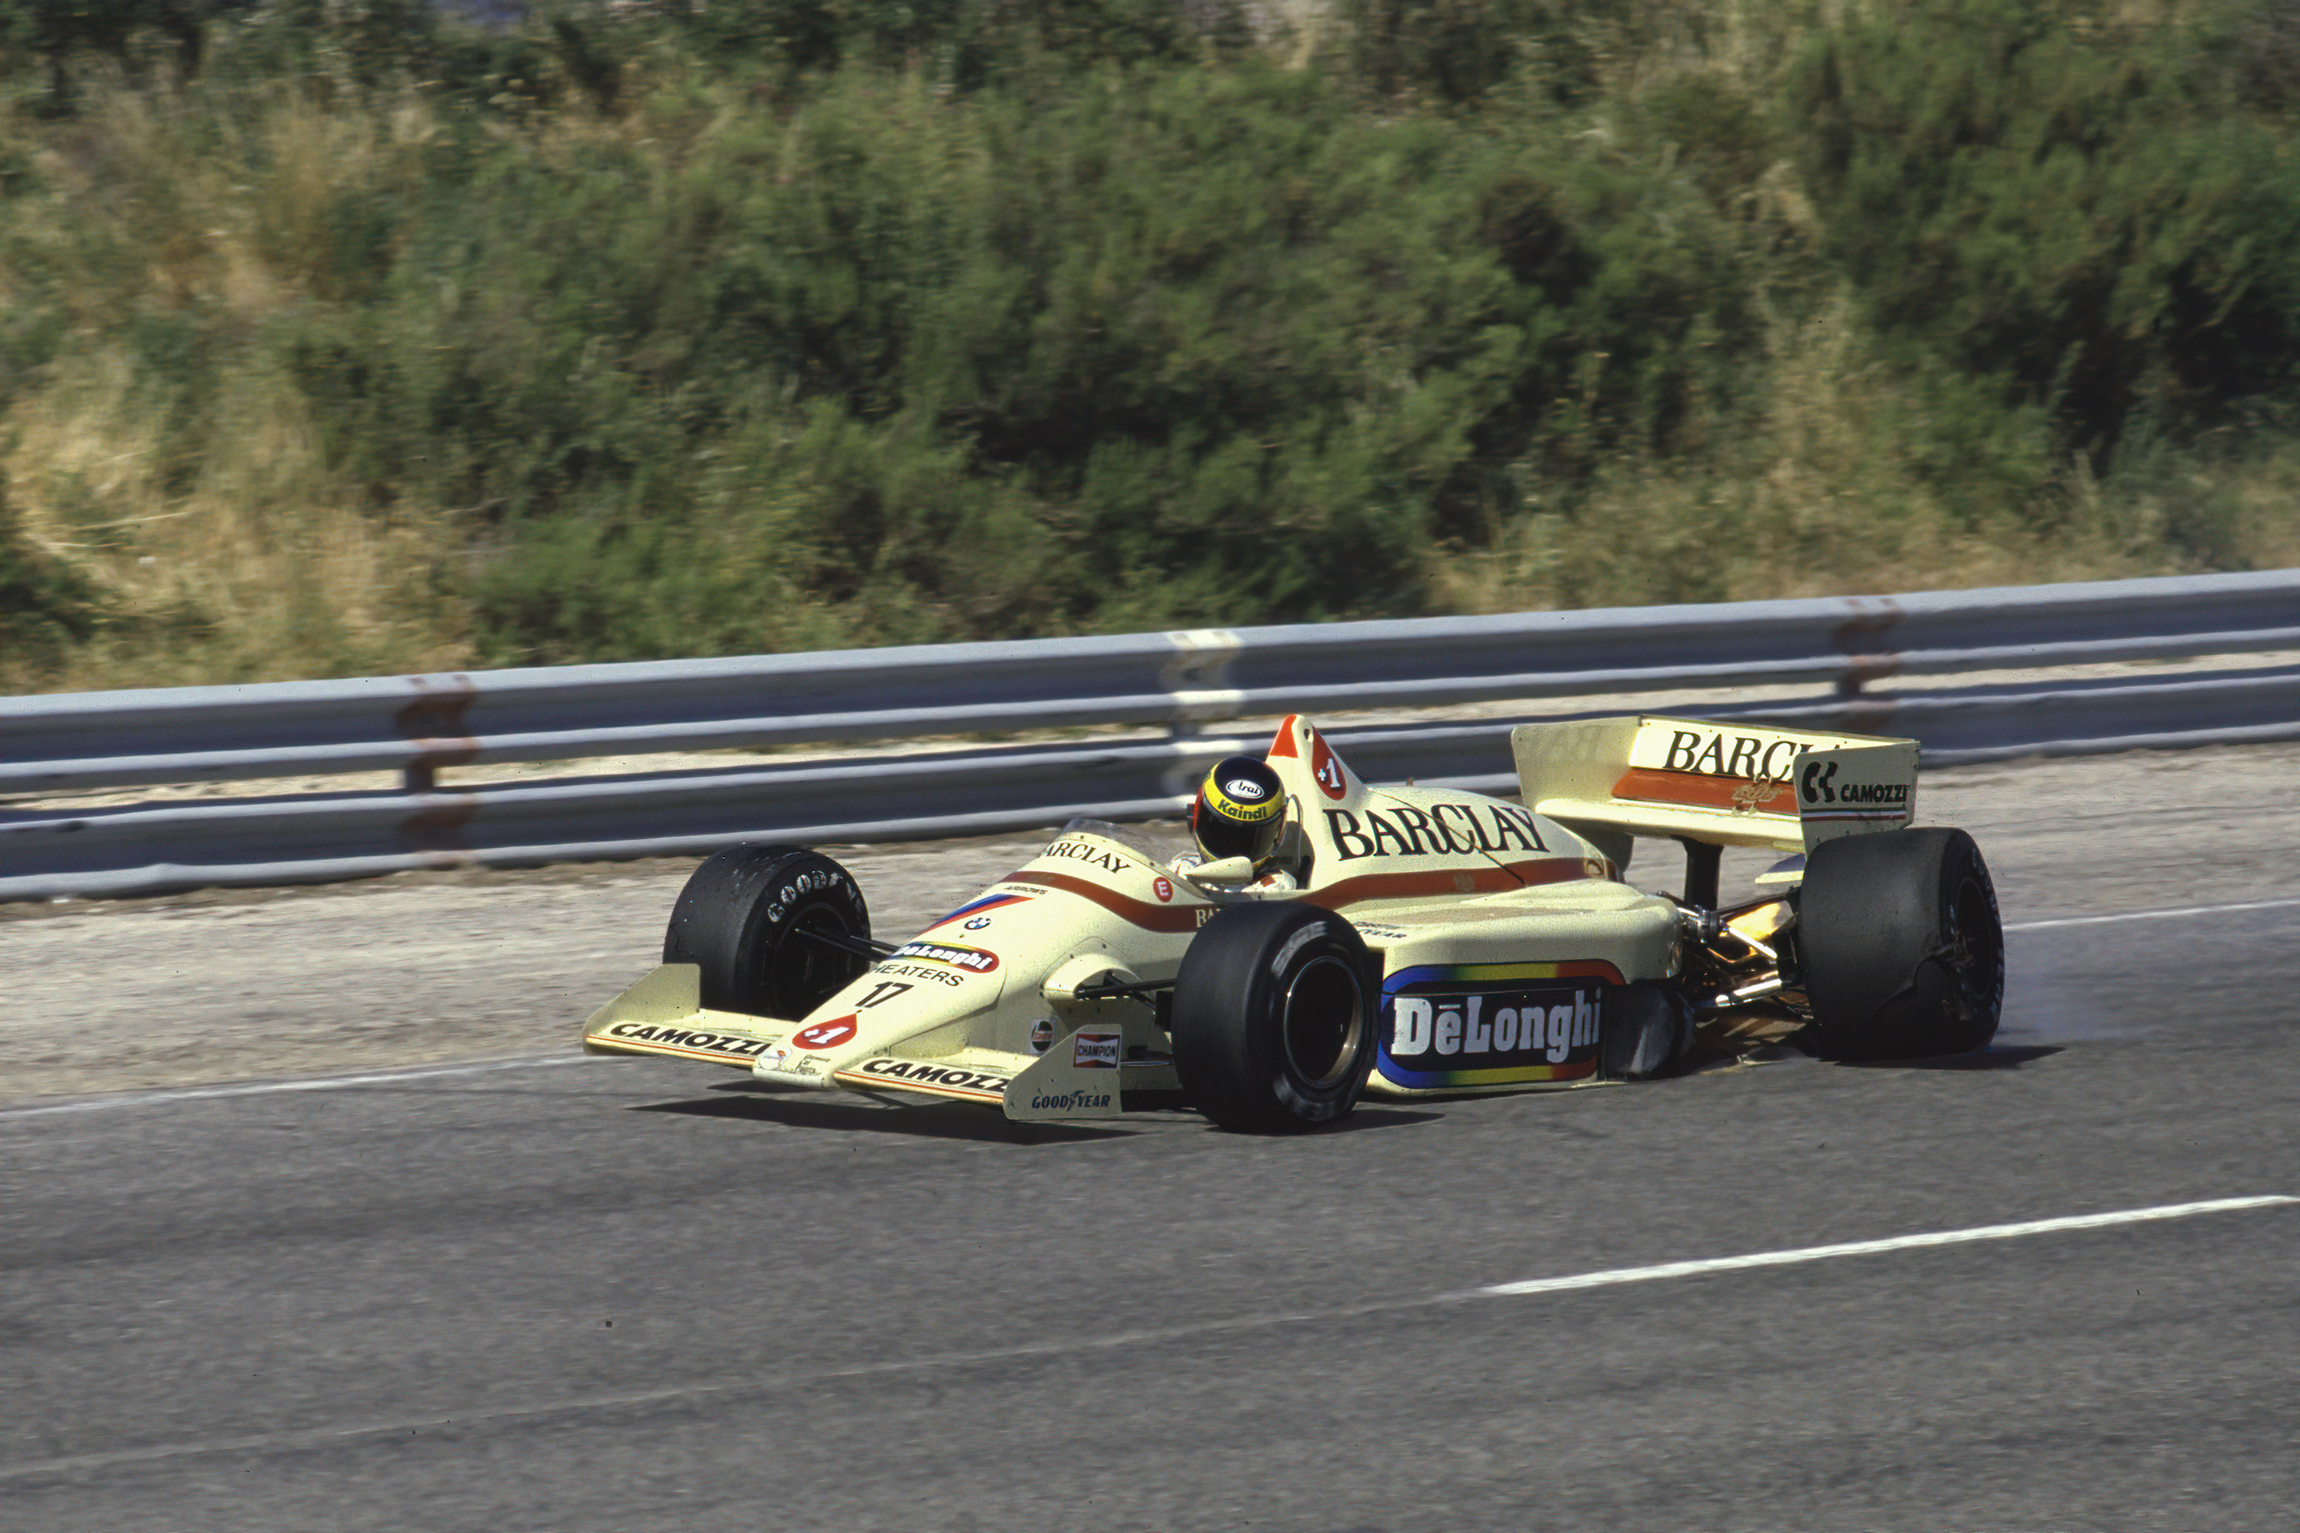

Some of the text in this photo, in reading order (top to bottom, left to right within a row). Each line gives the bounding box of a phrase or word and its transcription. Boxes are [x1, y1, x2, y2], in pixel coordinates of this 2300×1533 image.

[1662, 730, 1841, 783] BARC
[1317, 757, 1341, 788] +1
[1840, 784, 1909, 803] CAMOZZI
[1217, 799, 1267, 820] Kaindl
[1322, 804, 1550, 861] BARCLAY
[1045, 842, 1132, 874] ARCLAY
[1157, 881, 1169, 897] E
[872, 964, 965, 987] HEATERS
[855, 981, 915, 1008] 17
[610, 1023, 772, 1056] CAMOZZI
[1077, 1045, 1116, 1057] CHAMPION
[862, 1059, 1012, 1092] CAMOZZ
